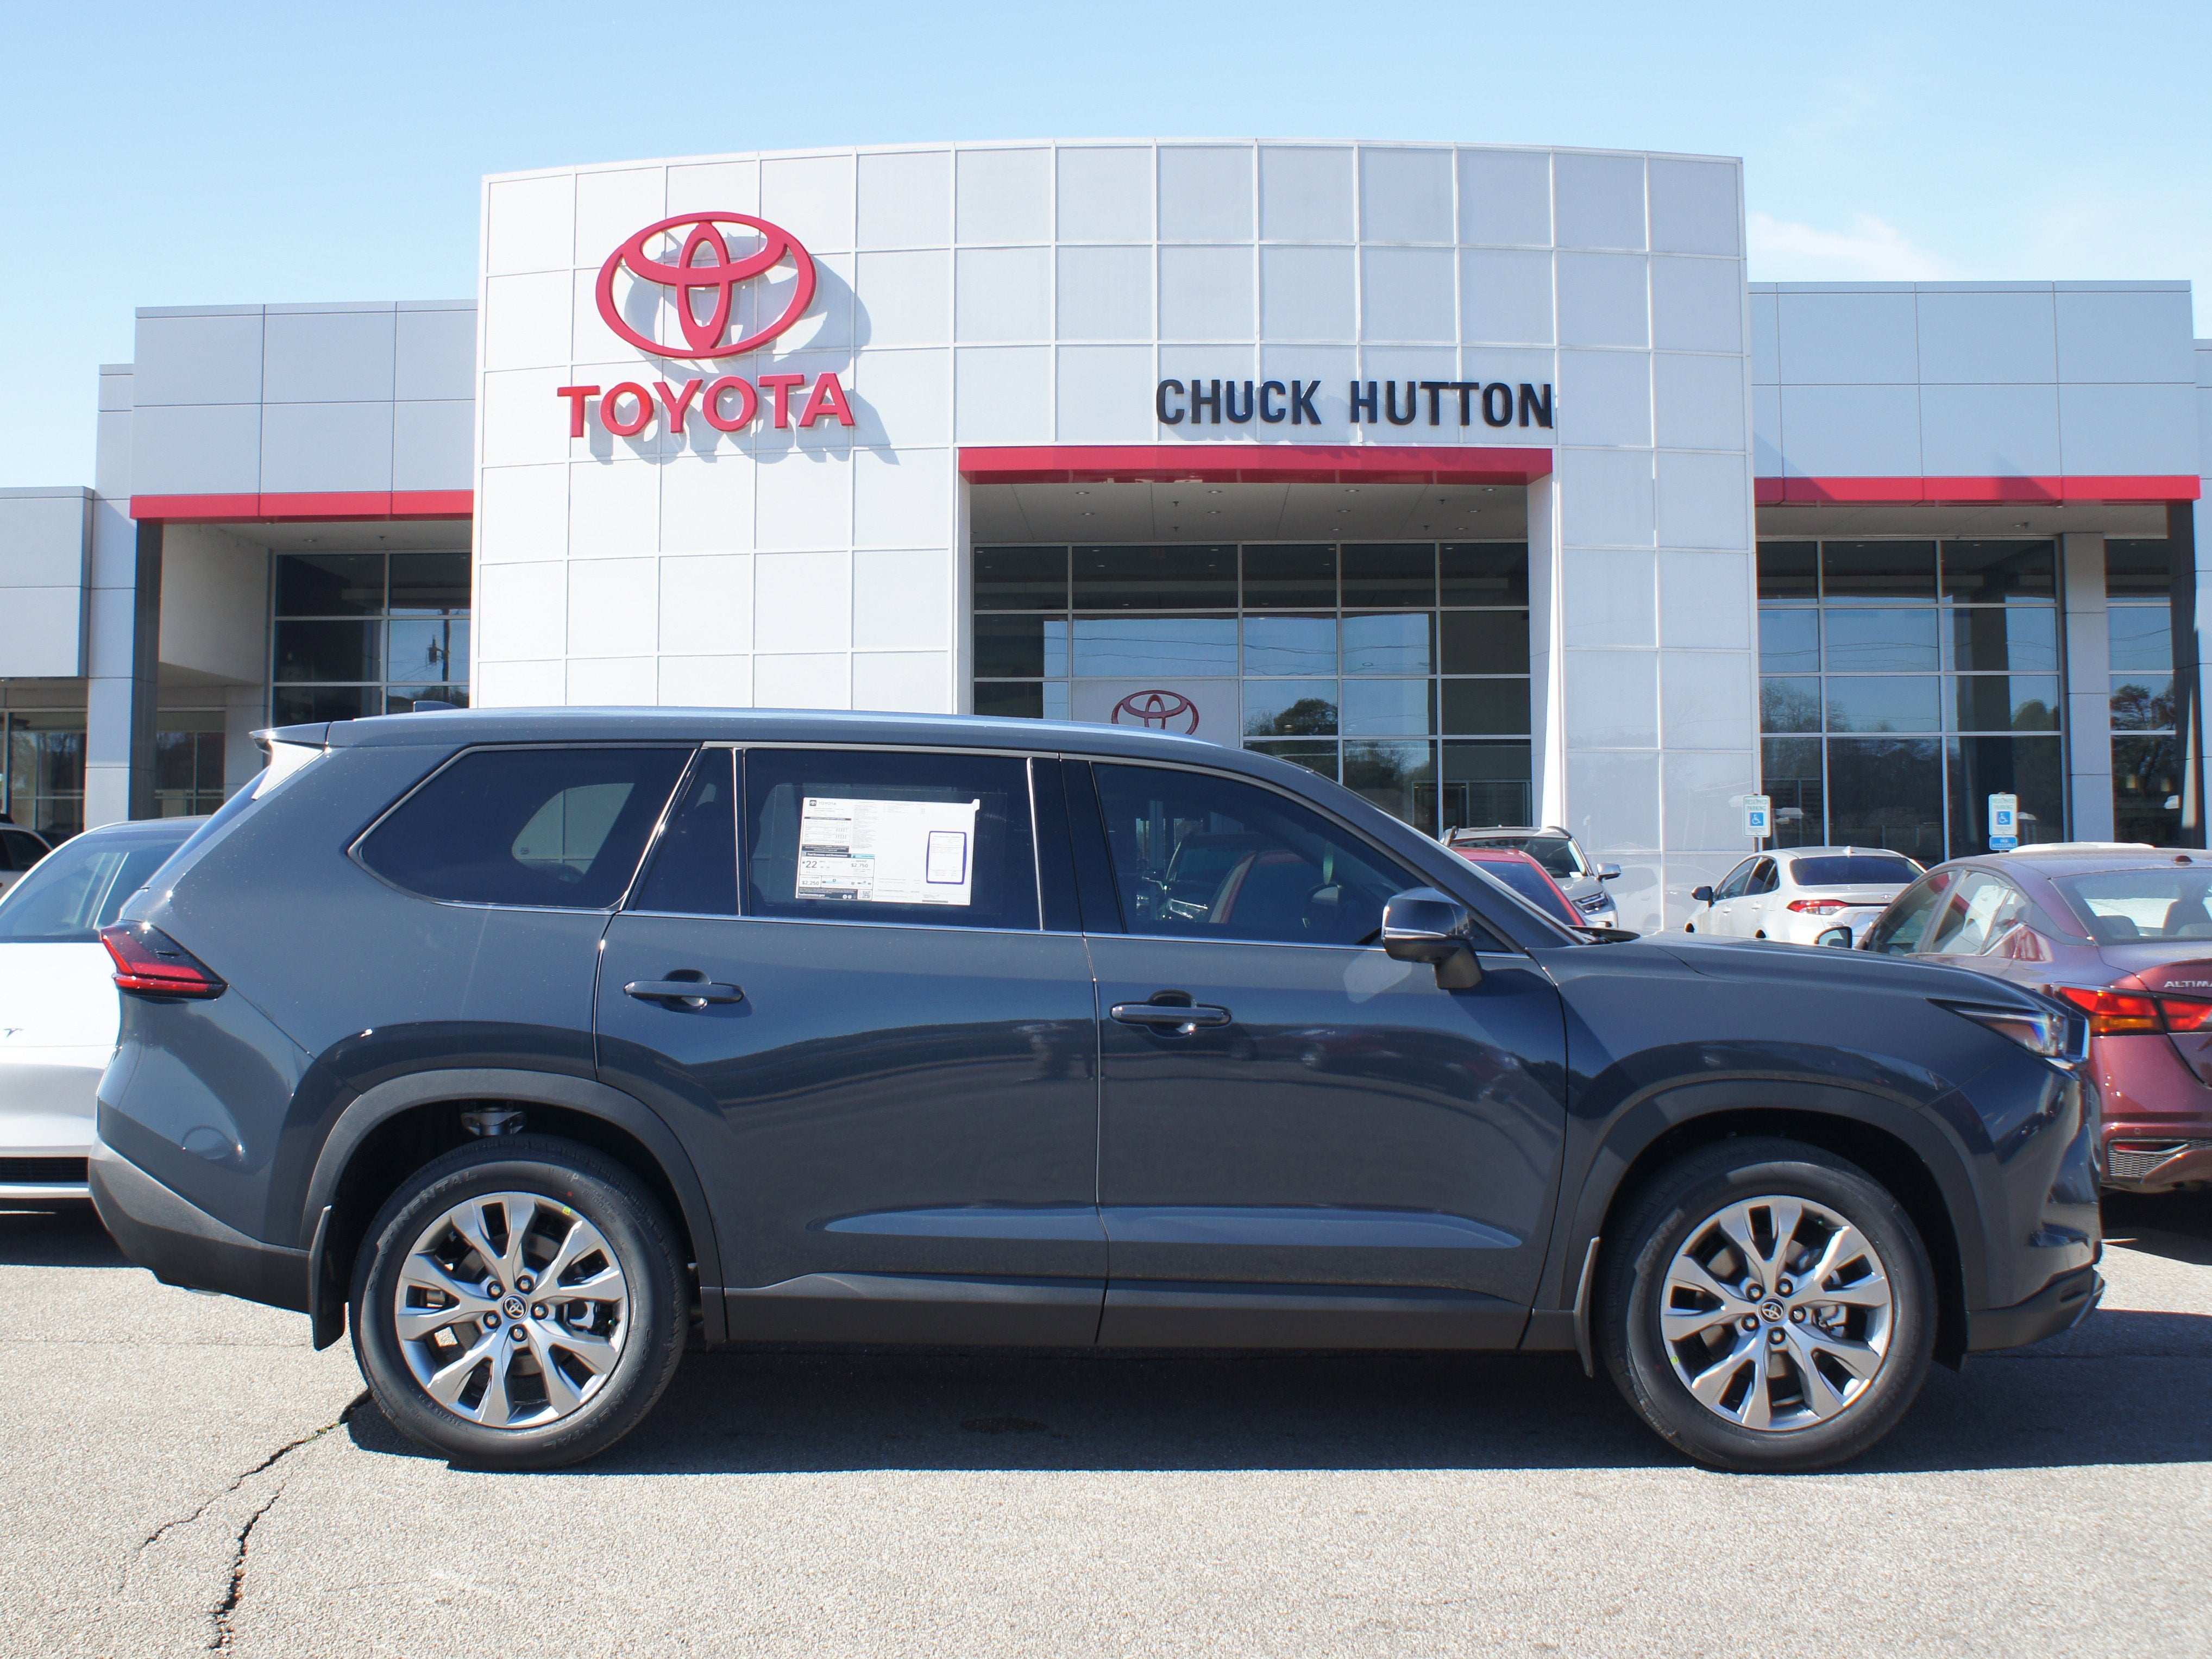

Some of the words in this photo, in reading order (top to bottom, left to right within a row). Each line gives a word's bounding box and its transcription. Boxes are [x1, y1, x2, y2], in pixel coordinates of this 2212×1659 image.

[557, 372, 856, 438] TOYOTA
[1156, 378, 1322, 425] CHUCK
[1350, 380, 1554, 429] HUTTON
[805, 860, 818, 869] 22
[368, 1171, 478, 1291] CONTINENTAL
